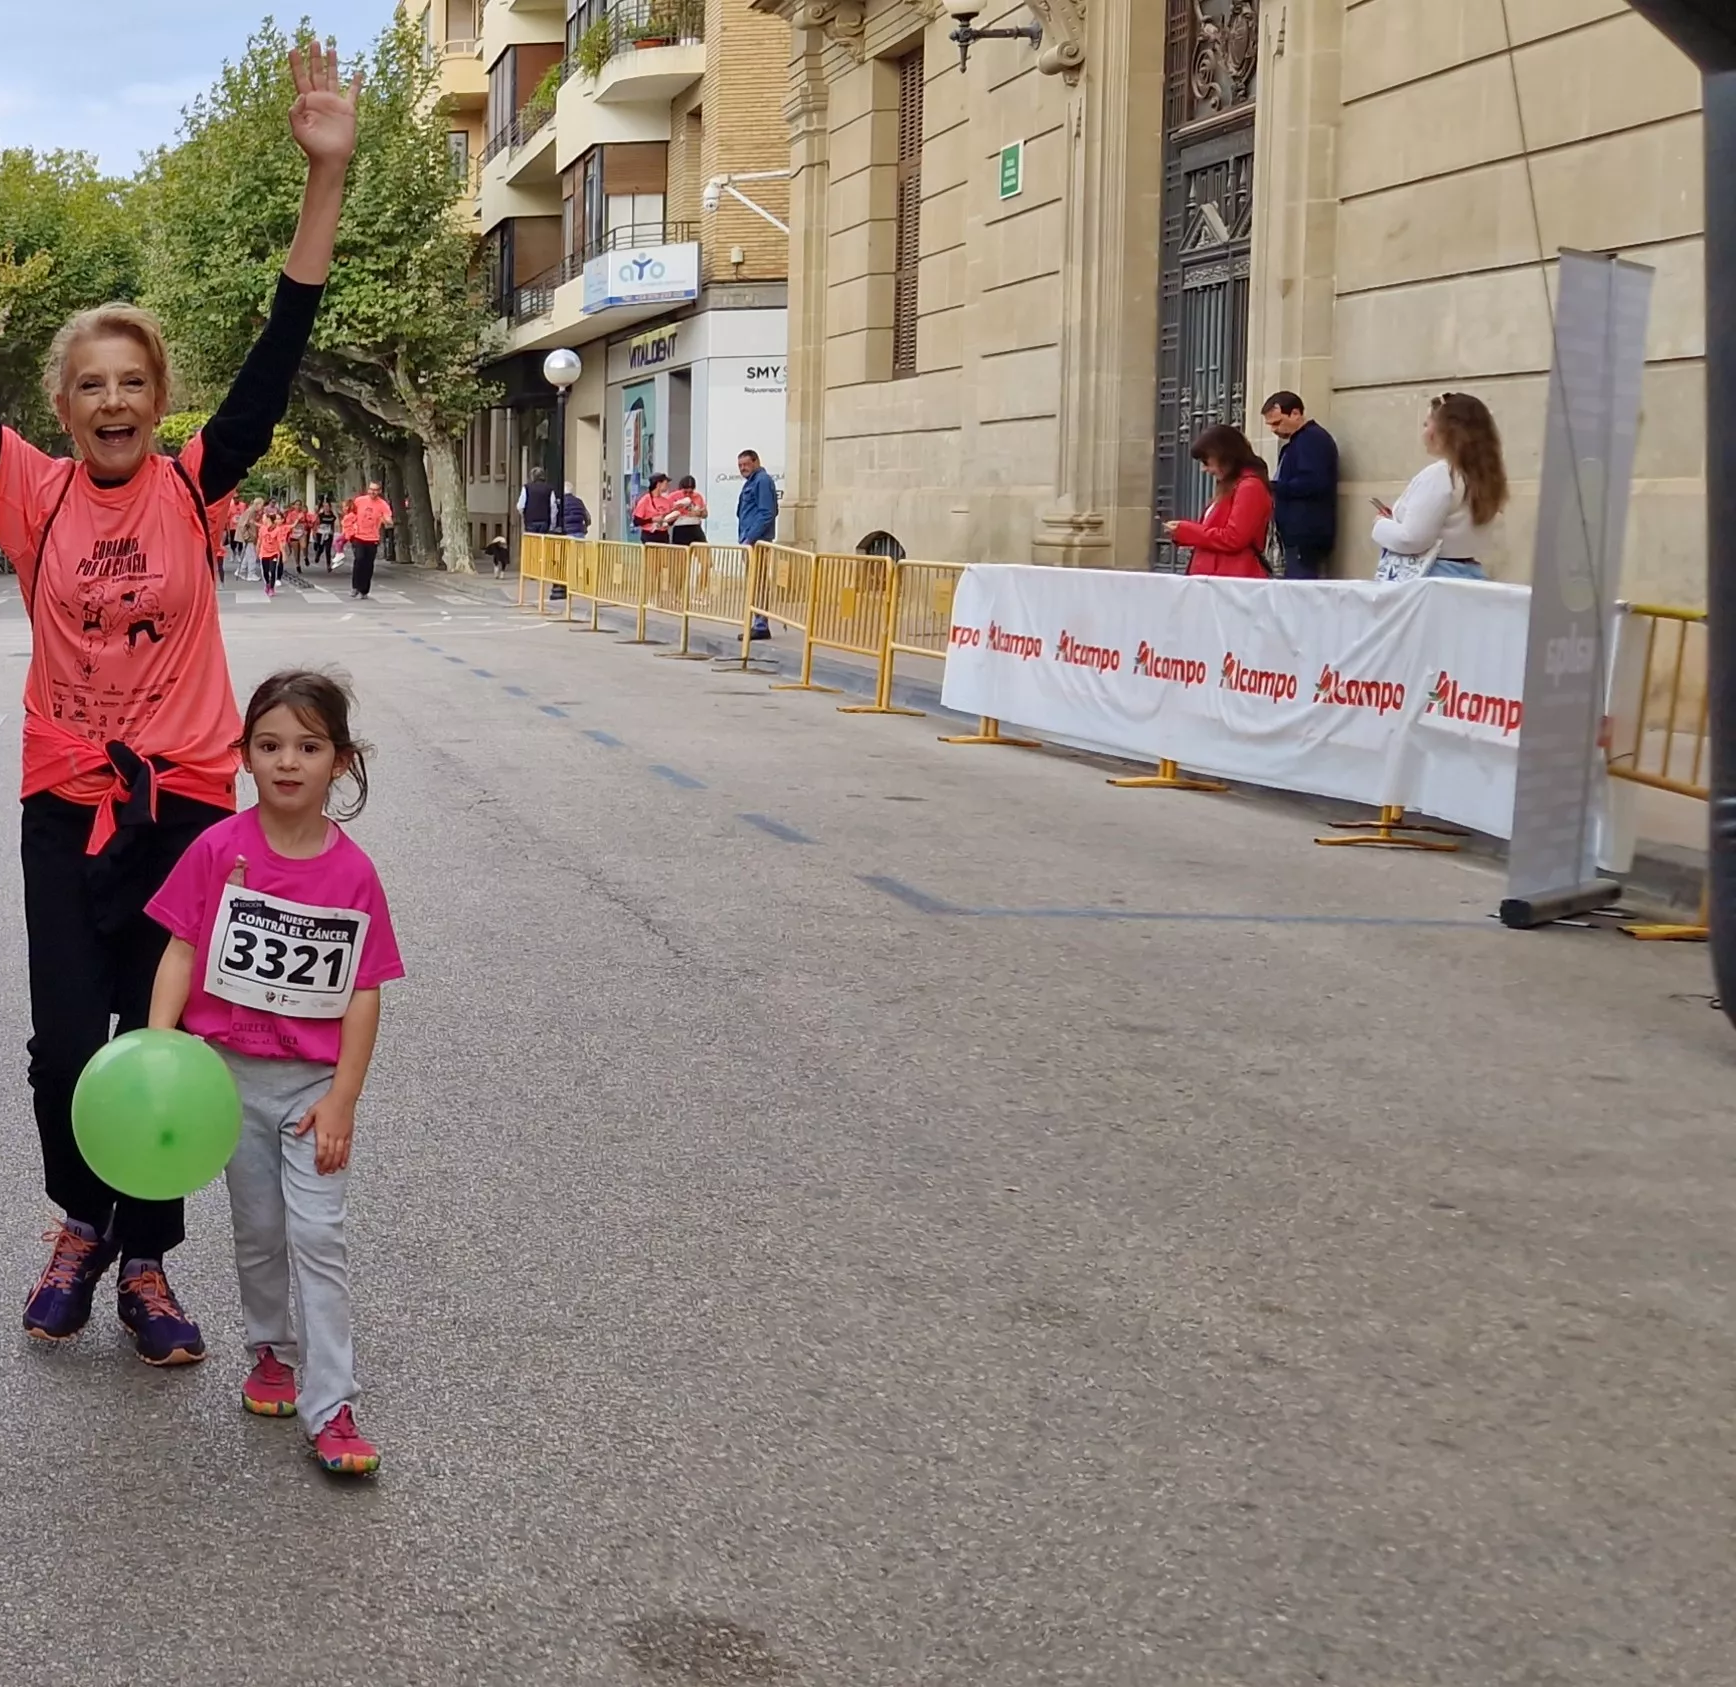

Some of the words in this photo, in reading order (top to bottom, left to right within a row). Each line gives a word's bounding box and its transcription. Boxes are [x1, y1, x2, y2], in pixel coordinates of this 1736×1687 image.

[629, 332, 679, 370] VITALDENT
[746, 366, 781, 379] SMY
[986, 620, 1043, 661] Alcampo
[1054, 629, 1121, 675] Alcampo
[1133, 640, 1206, 689] Alcampo
[1219, 651, 1298, 704] Alcampo
[1312, 663, 1405, 716] Alcampo
[1425, 670, 1523, 737] Alcamp
[238, 912, 286, 934] CONTRA
[288, 926, 303, 938] EL
[305, 926, 349, 942] CÁNCER
[279, 913, 315, 927] HUESCA
[224, 929, 345, 988] 3321
